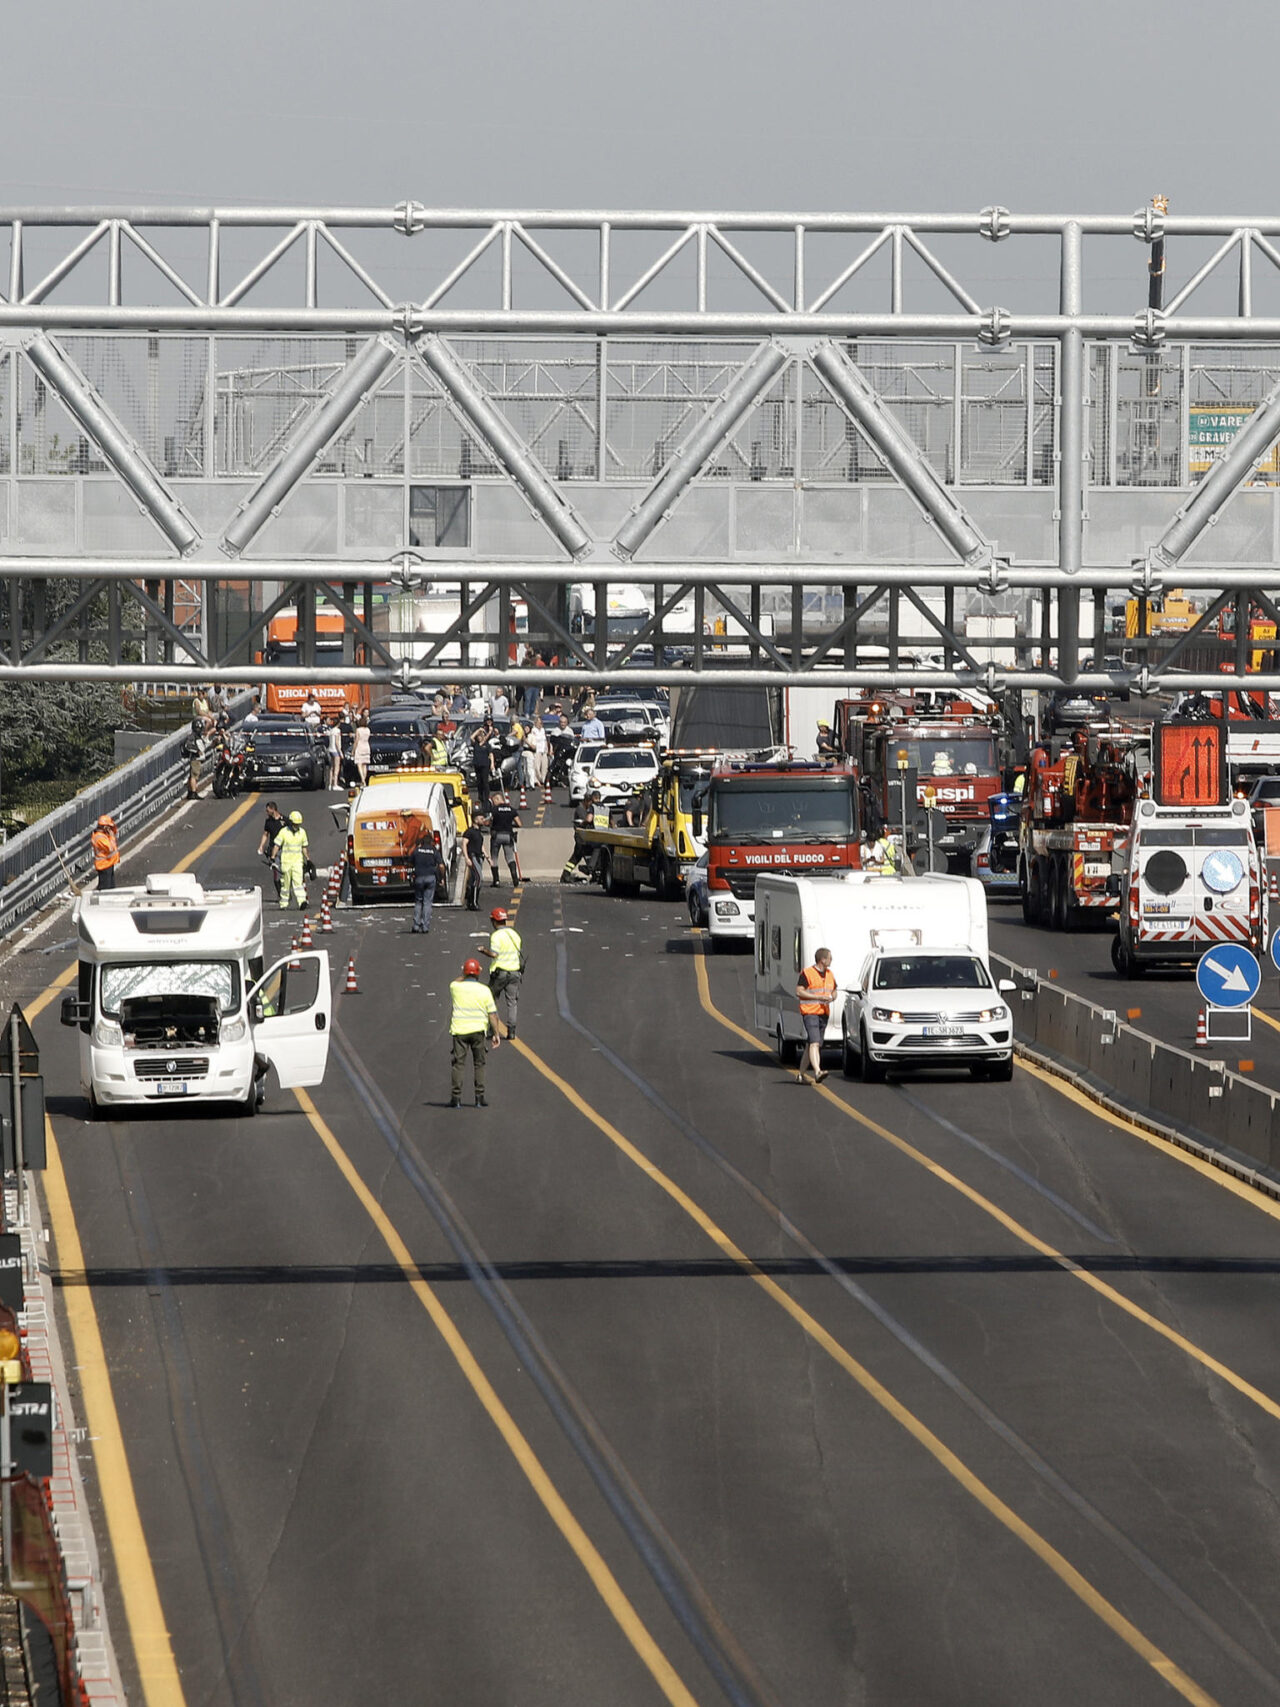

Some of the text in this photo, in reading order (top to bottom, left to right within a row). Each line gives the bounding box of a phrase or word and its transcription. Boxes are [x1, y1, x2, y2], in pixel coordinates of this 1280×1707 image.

[745, 854, 825, 864] VIGILI DEL FUOCO
